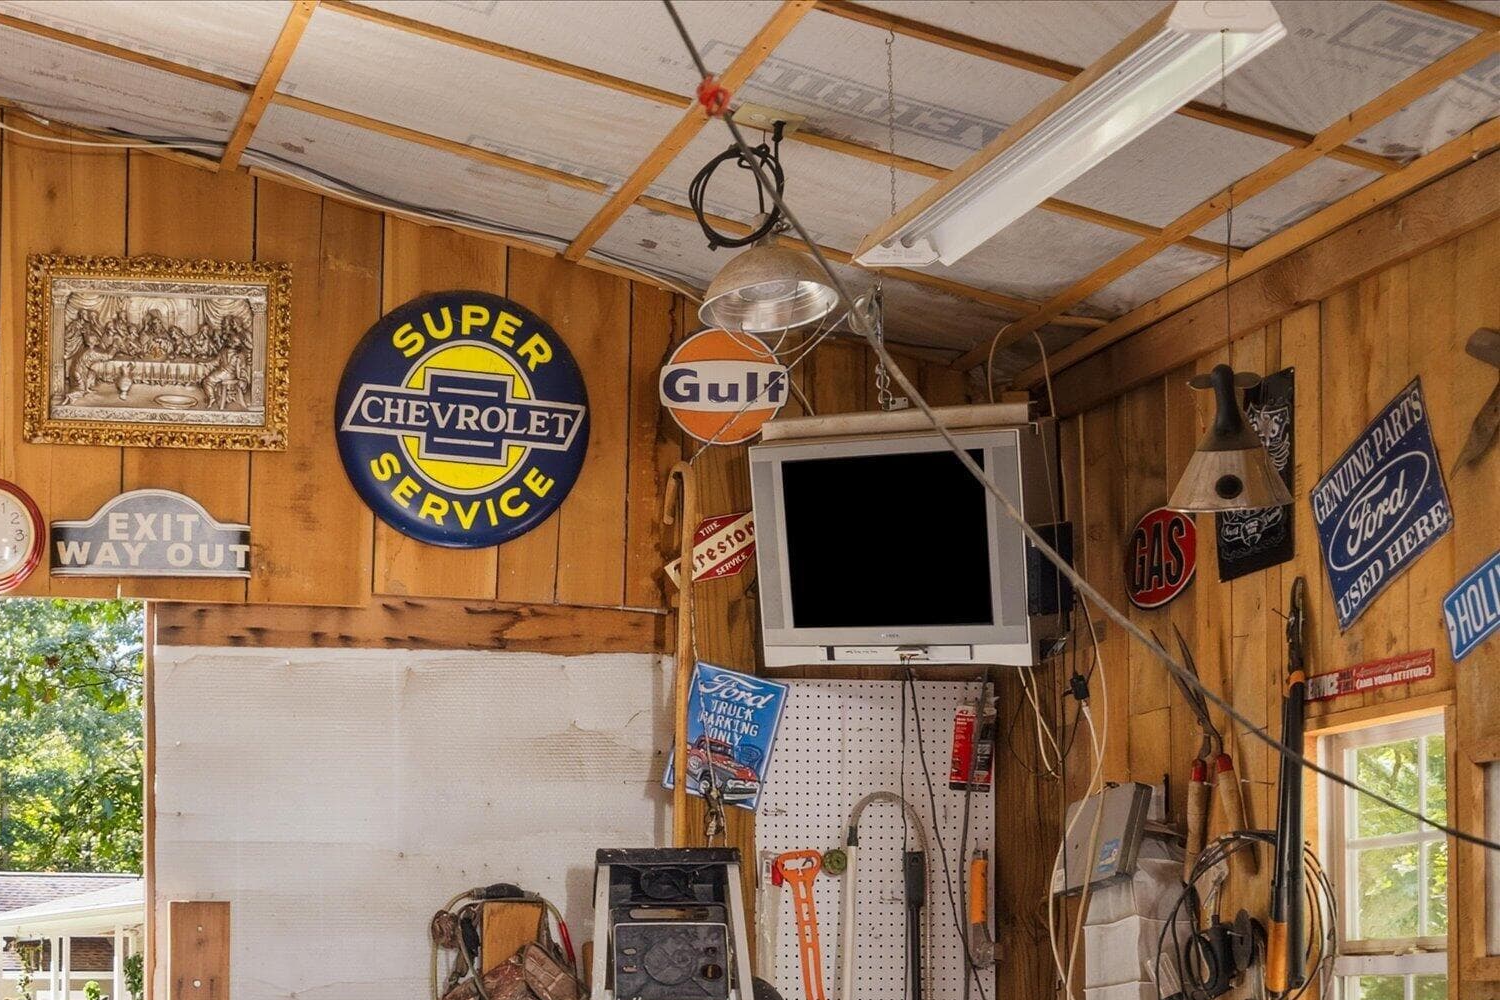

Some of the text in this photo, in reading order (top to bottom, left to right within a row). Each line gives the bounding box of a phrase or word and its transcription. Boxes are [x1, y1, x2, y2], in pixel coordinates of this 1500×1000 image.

[392, 304, 553, 372] SUPER
[663, 367, 786, 403] Gulf
[361, 396, 574, 439] CHEVROLET
[1313, 389, 1424, 525] GENUINE PARTS
[370, 452, 555, 531] SERVICE
[10, 512, 20, 525] 2
[108, 512, 199, 541] EXIT
[1347, 470, 1409, 557] Ford
[15, 529, 25, 541] 3
[673, 519, 756, 576] reston
[56, 541, 250, 568] WAY OUT
[715, 552, 748, 576] SERVICE
[1133, 516, 1187, 595] GAS
[1338, 500, 1448, 620] USED HERE
[700, 674, 775, 709] Ford
[711, 700, 754, 721] TRUCK
[708, 727, 743, 746] ONLY
